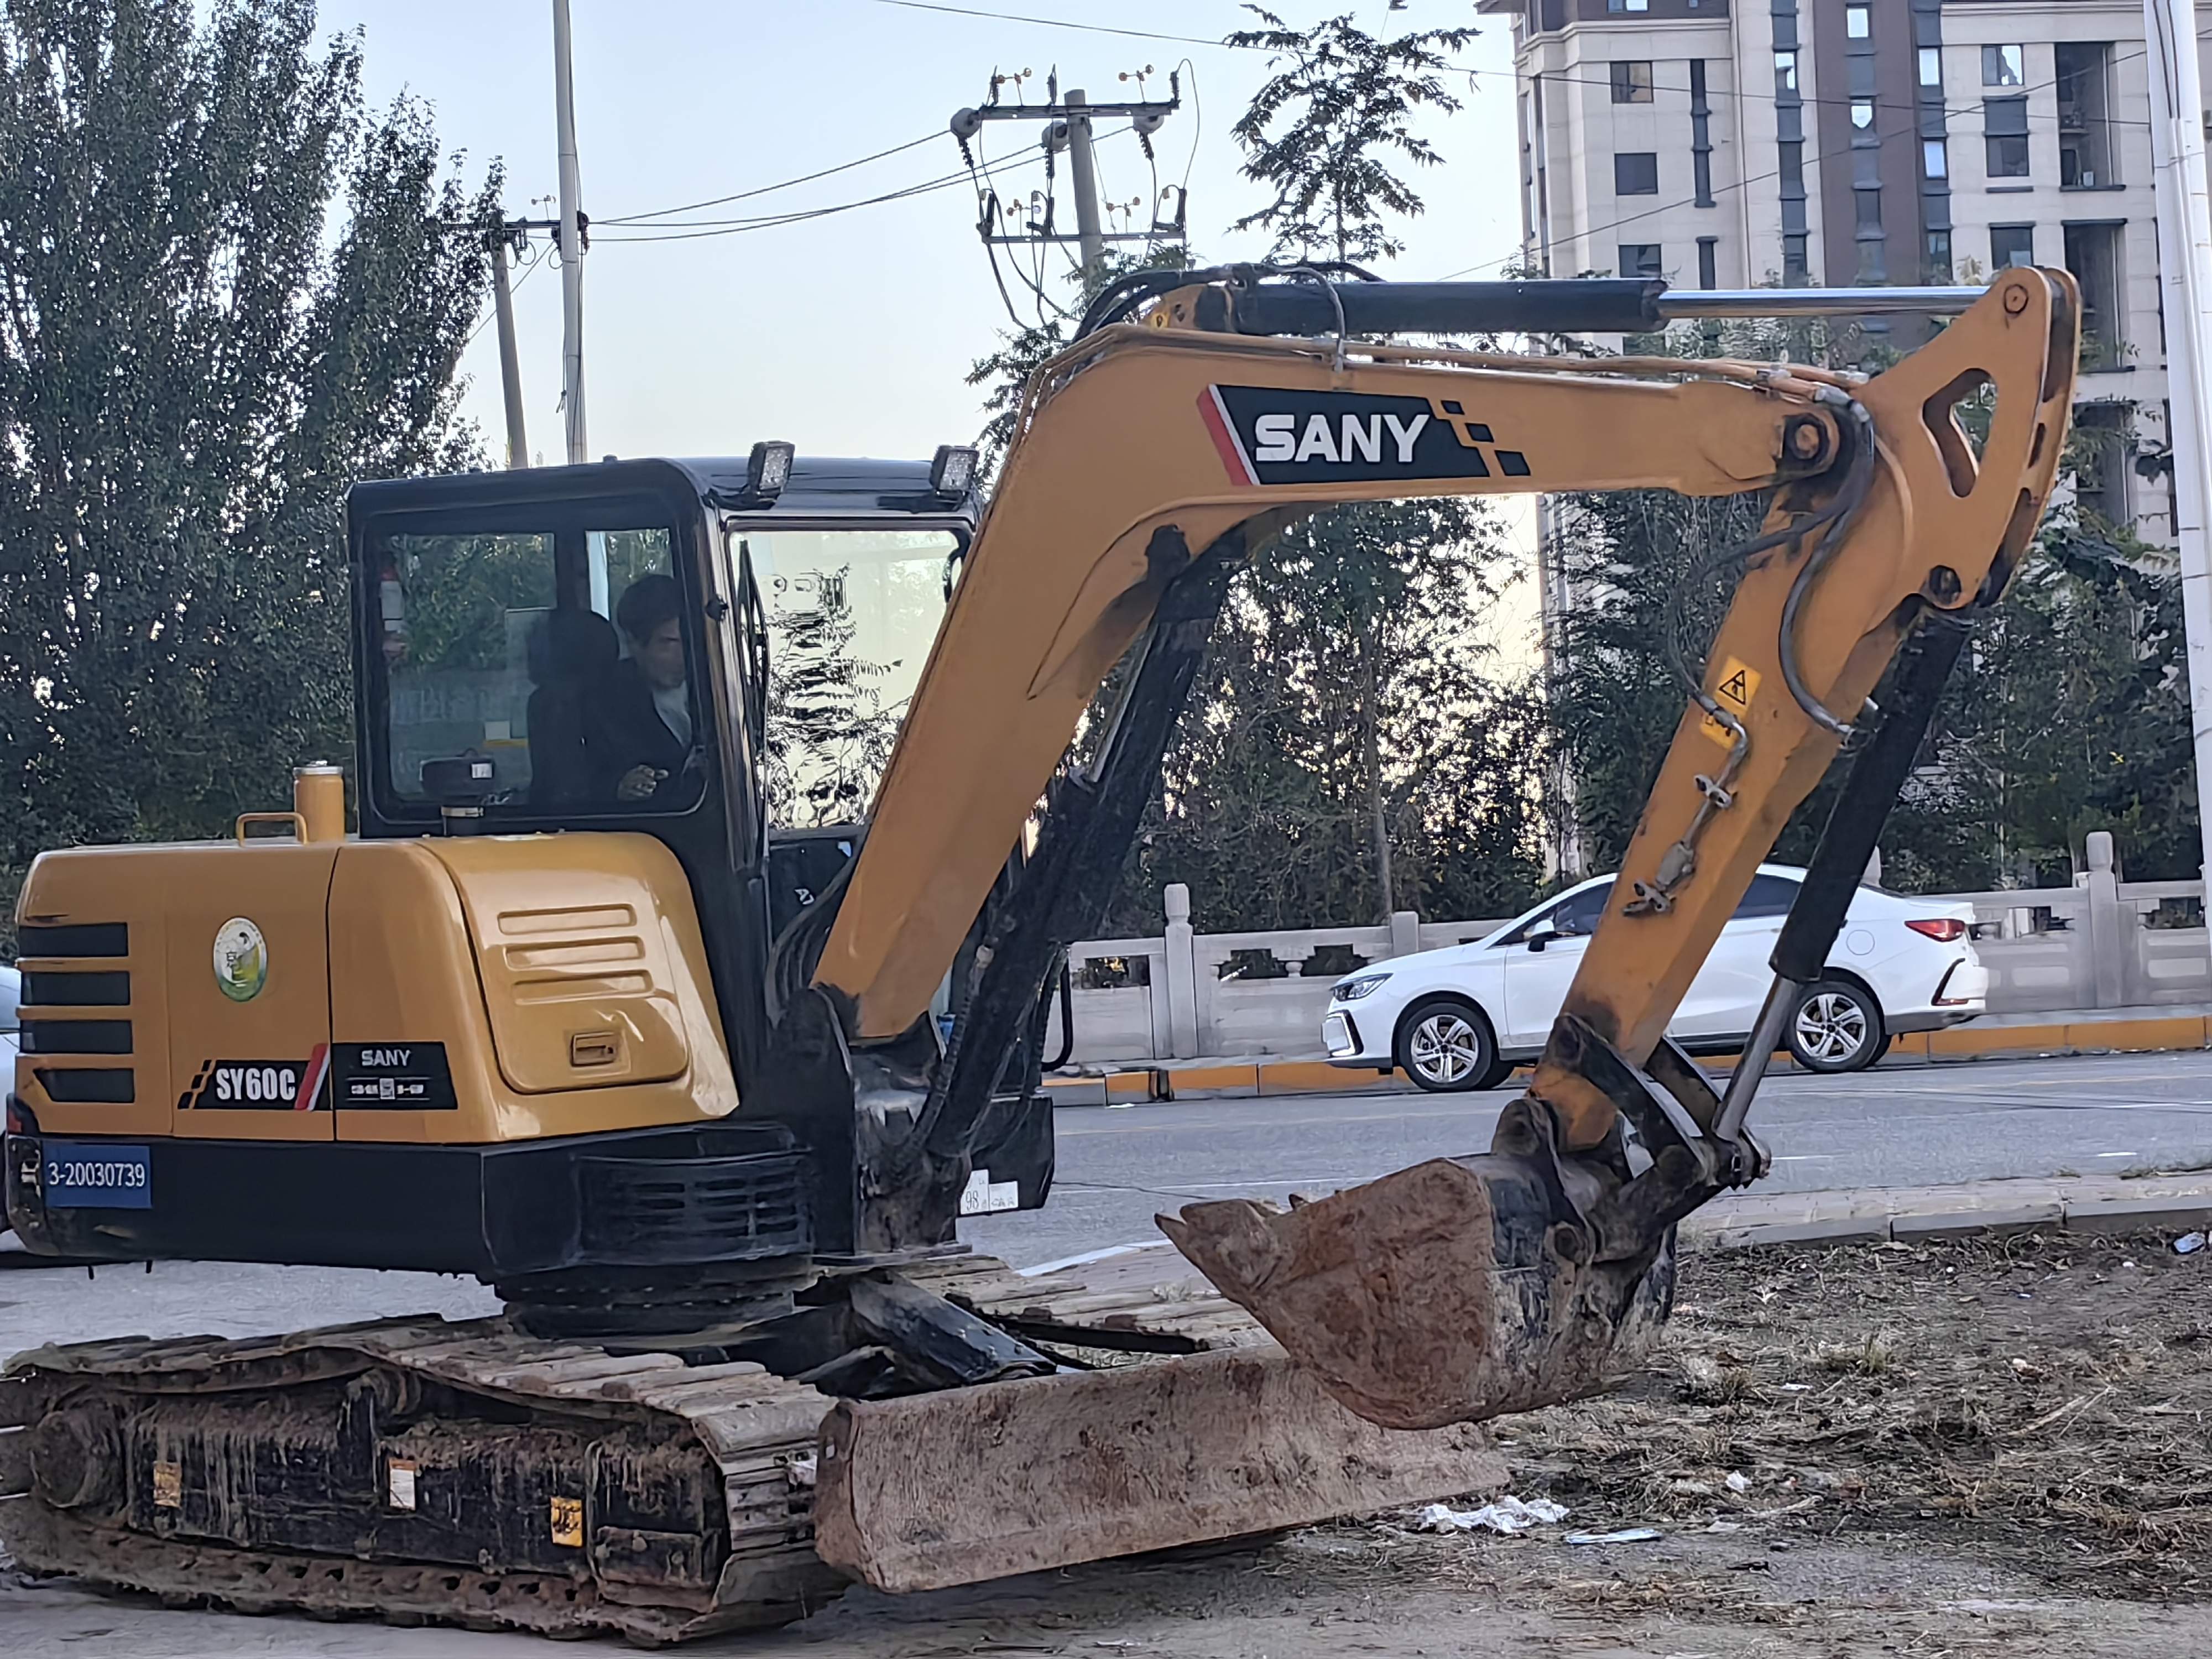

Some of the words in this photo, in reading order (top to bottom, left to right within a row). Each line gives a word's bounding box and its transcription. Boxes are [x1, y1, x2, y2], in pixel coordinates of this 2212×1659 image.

[1254, 414, 1431, 463] SANY
[361, 1048, 411, 1066] SANY
[215, 1067, 296, 1100] SY60C
[48, 1162, 145, 1187] 3-20030739
[965, 1190, 979, 1211] 98
